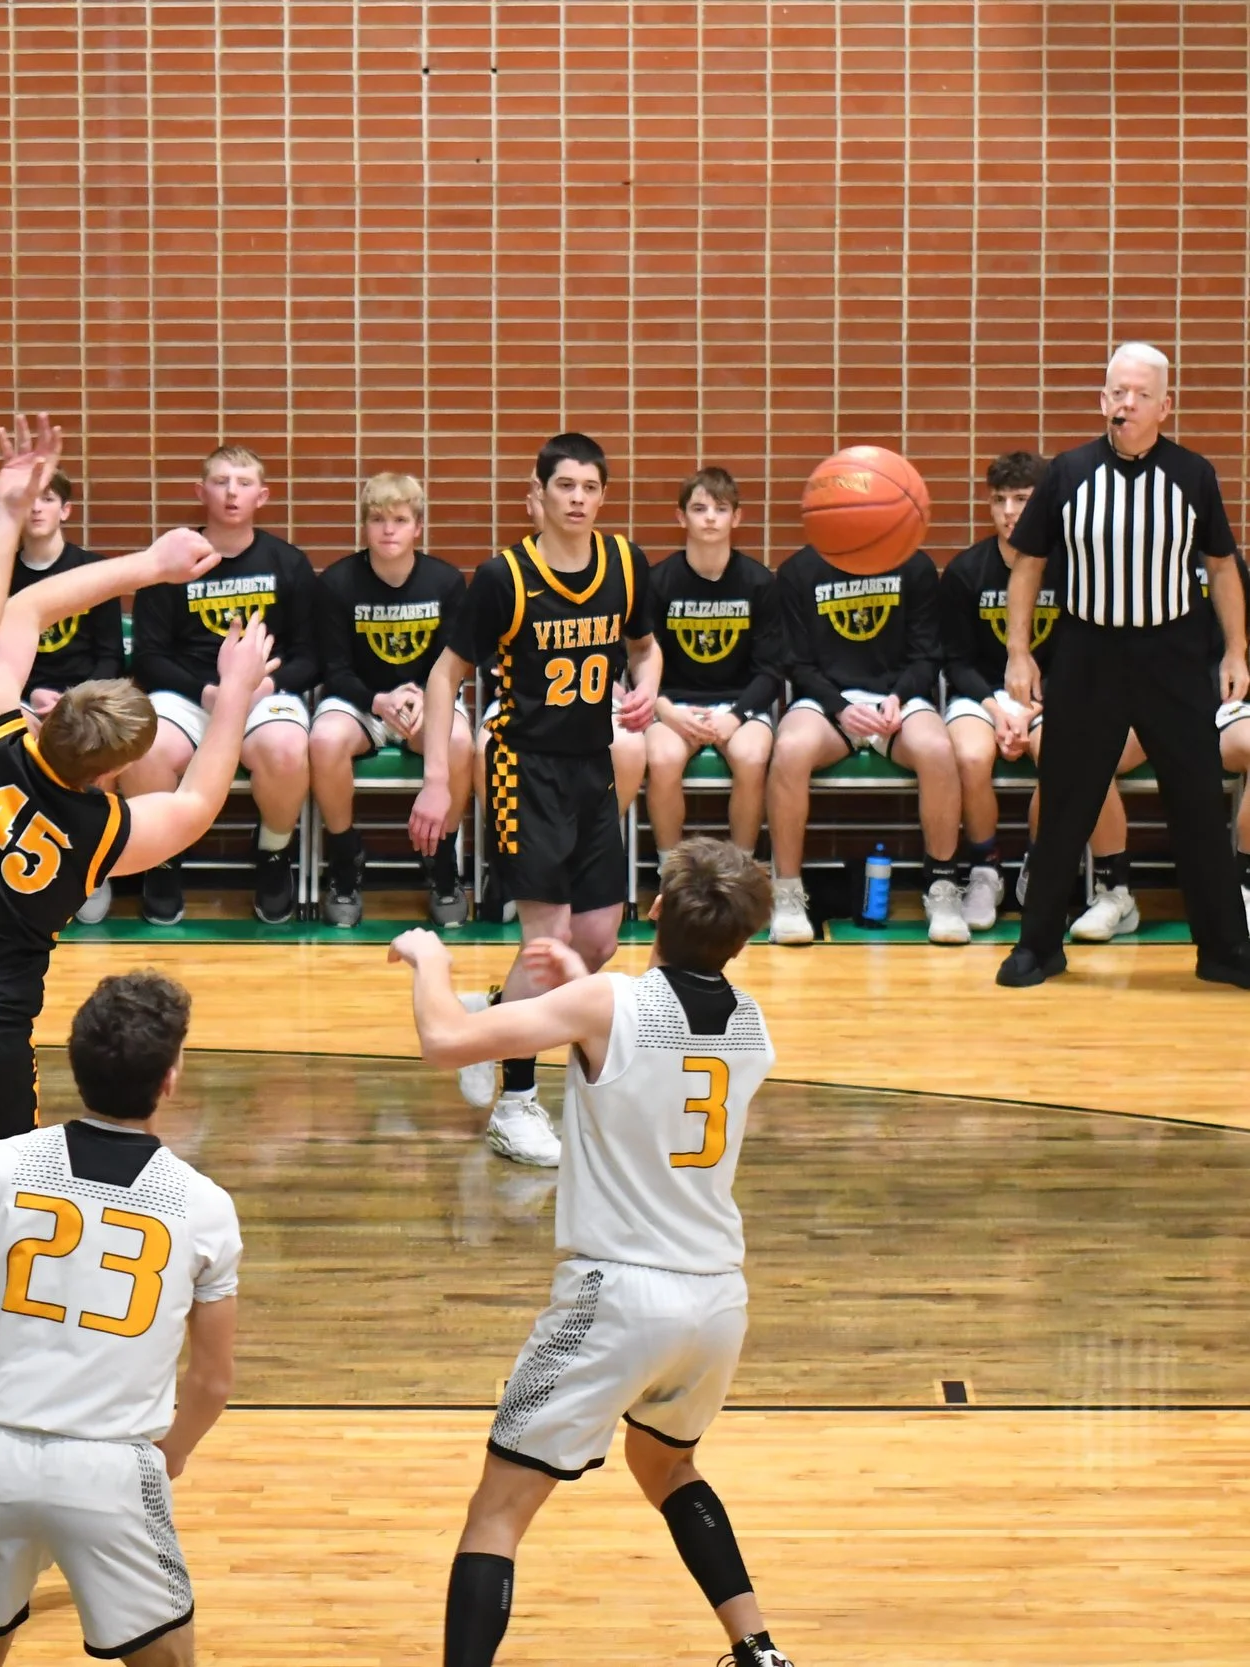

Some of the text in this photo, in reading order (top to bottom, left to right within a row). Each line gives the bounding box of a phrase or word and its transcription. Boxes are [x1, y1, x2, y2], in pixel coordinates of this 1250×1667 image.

[187, 575, 276, 600] ST ELIZABETH
[815, 576, 901, 603] ST ELIZABETH
[979, 590, 996, 607] ST
[355, 601, 440, 621] ST ELIZABETH
[667, 600, 750, 617] ST ELIZABETH
[532, 613, 620, 651] VIENNA
[544, 653, 608, 707] 20
[669, 1056, 730, 1169] 3
[1, 1191, 172, 1338] 23
